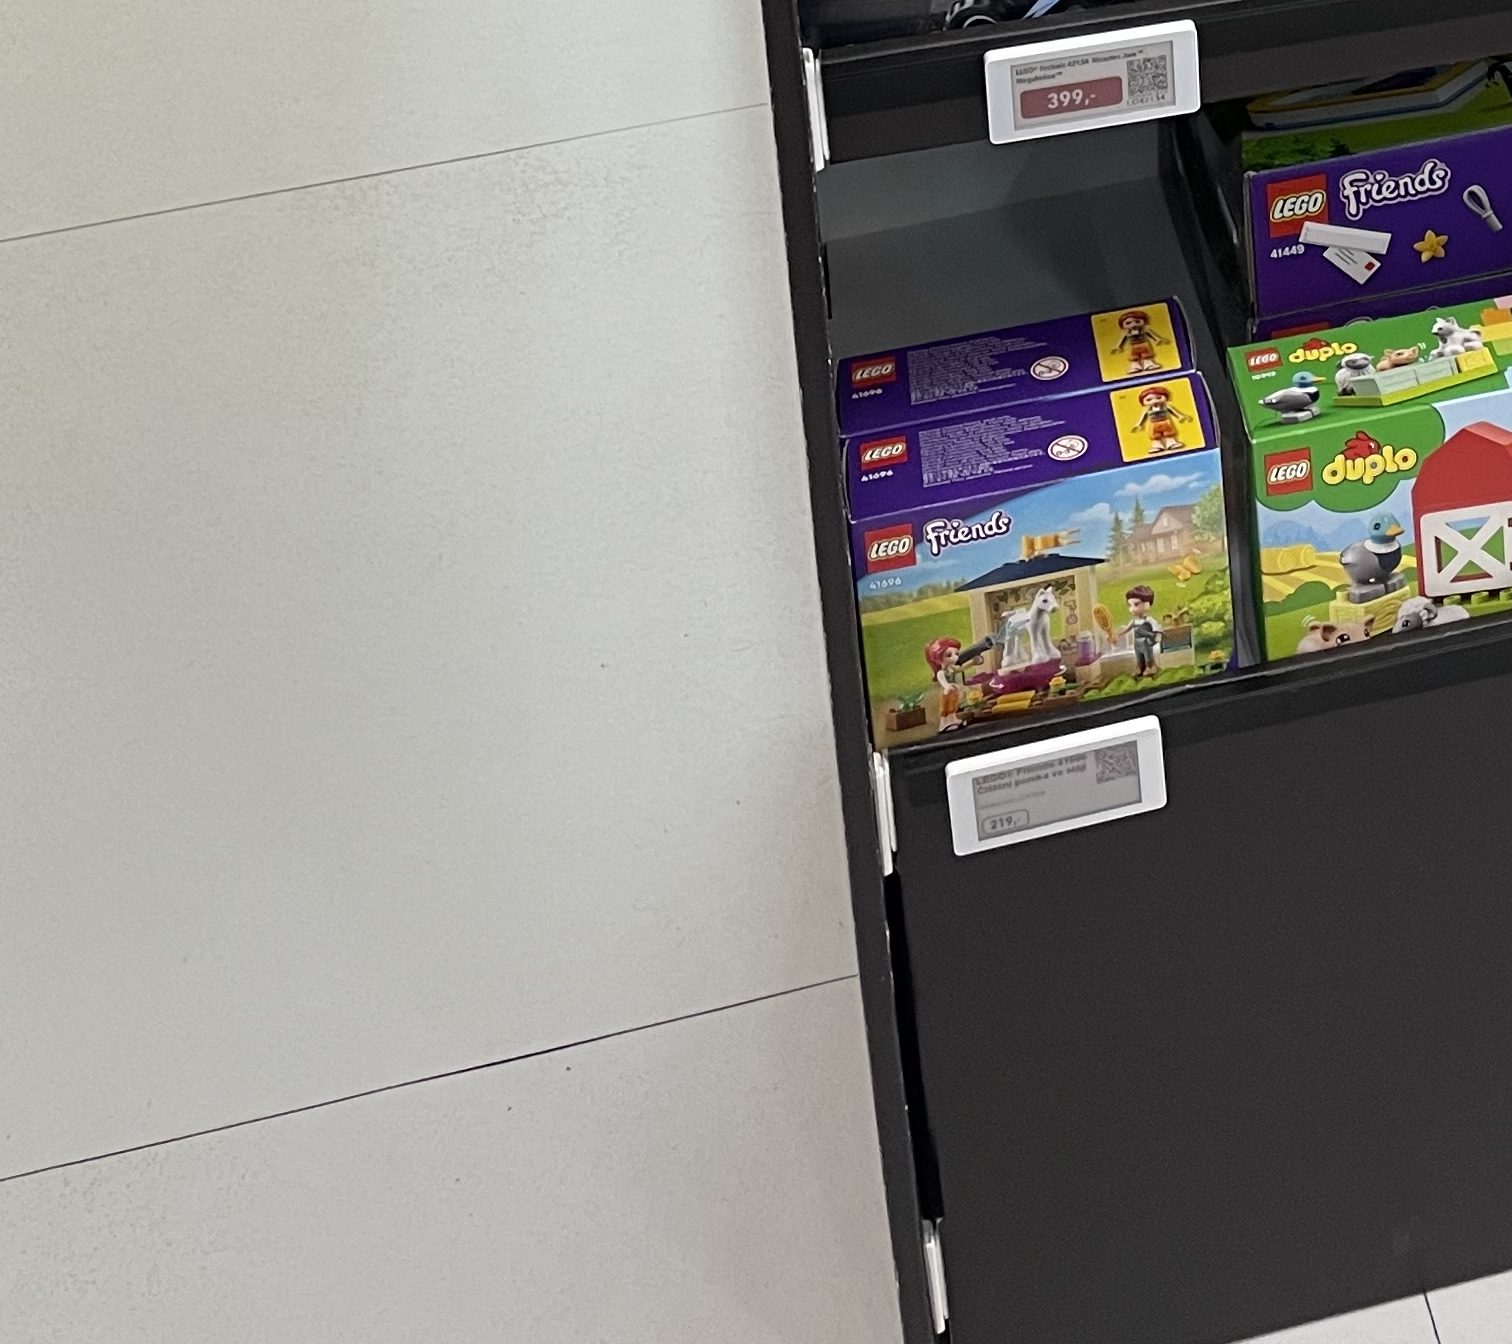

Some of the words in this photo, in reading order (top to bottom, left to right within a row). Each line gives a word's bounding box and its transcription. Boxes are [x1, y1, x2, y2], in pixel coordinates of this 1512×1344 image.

[1047, 88, 1096, 109] 399,-
[1270, 188, 1326, 224] LEGO
[1339, 157, 1450, 220] Friends
[1270, 243, 1306, 259] 41449
[1248, 353, 1279, 366] LEGO
[1288, 342, 1358, 363] duplo
[851, 361, 894, 382] LEGO
[861, 440, 906, 462] LEGO
[1267, 459, 1310, 487] LEGO
[1321, 443, 1419, 487] duplo
[868, 534, 914, 563] LEGO
[923, 511, 1014, 556] Friends
[869, 575, 902, 591] 41696
